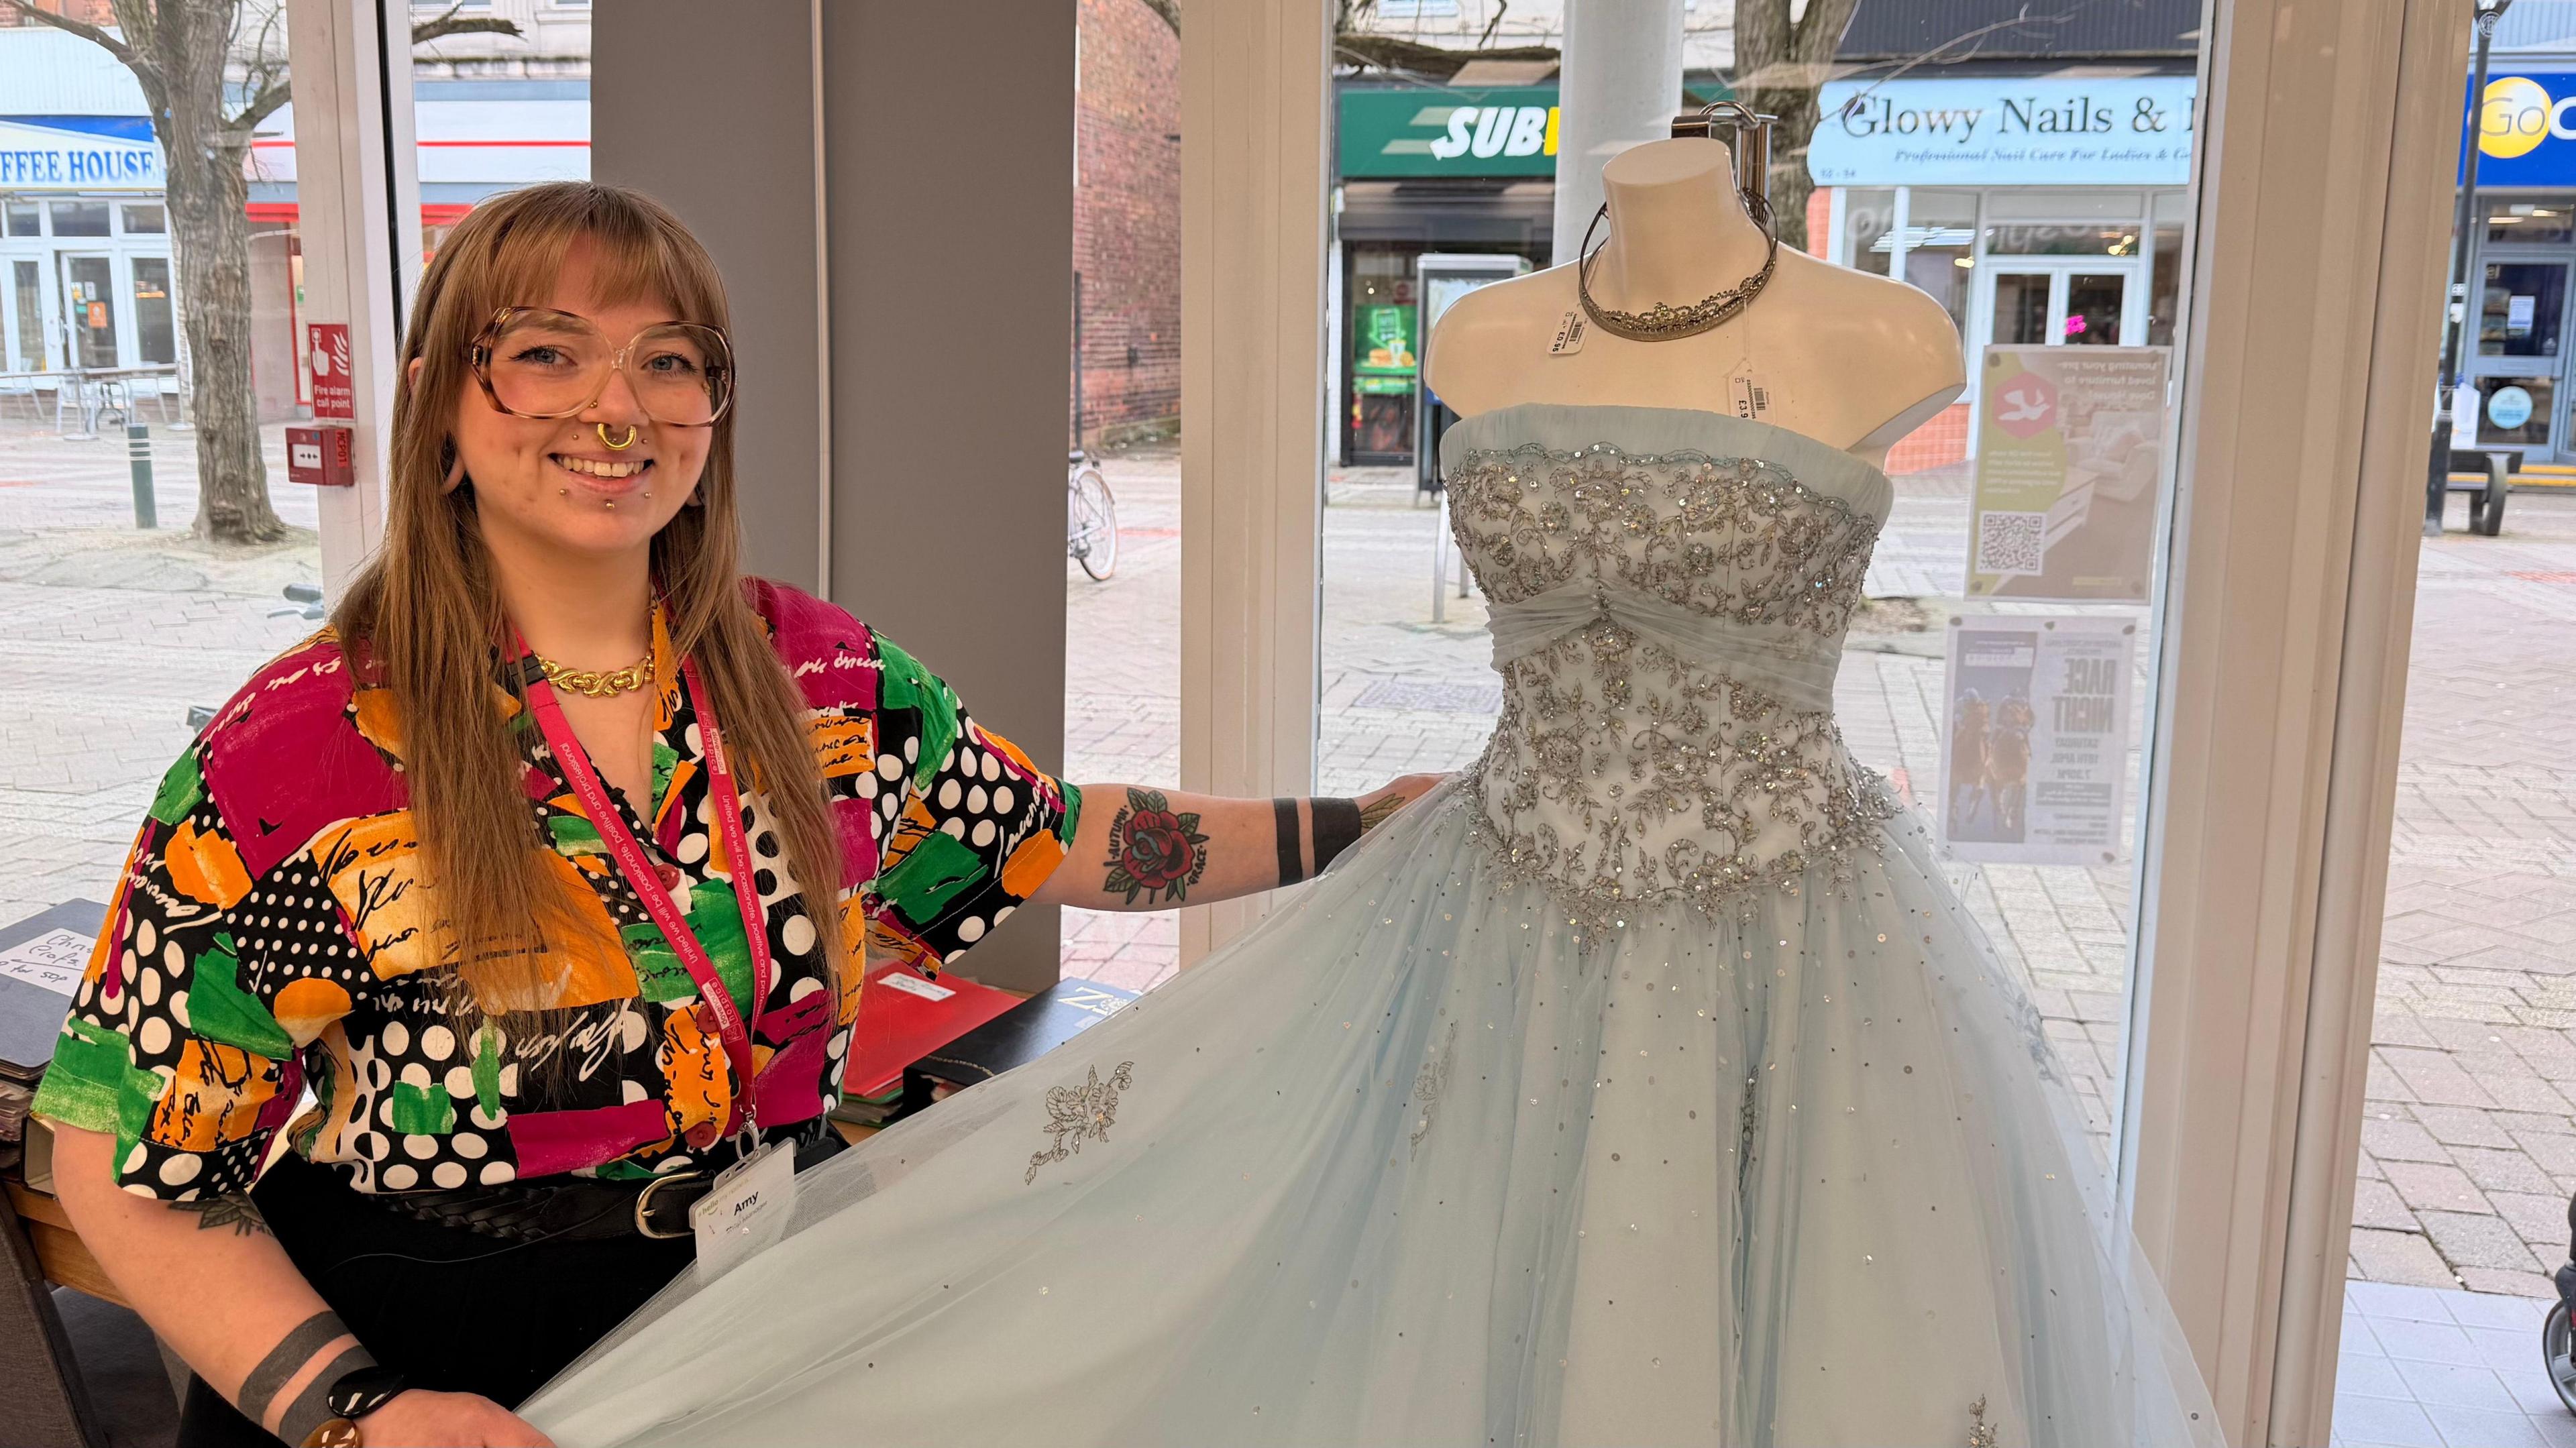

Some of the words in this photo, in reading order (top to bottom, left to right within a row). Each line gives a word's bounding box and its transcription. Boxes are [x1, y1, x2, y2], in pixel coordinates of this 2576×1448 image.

[1842, 92, 1982, 143] Glowy
[1998, 97, 2112, 134] Nails
[2133, 97, 2166, 133] &
[67, 151, 155, 181] HOUSE
[314, 384, 328, 395] Fire
[329, 386, 351, 395] alarm
[316, 398, 329, 407] call
[331, 398, 350, 409] point
[705, 730, 717, 771] hospice
[559, 742, 594, 791] professional
[585, 791, 602, 810] and
[599, 810, 623, 843] positive
[1108, 807, 1129, 856] AUTUMN
[621, 842, 654, 891] passionate,
[722, 795, 735, 822] United
[729, 824, 737, 838] we
[733, 839, 743, 852] will
[739, 871, 755, 921] passionate,
[751, 923, 763, 956] positive
[651, 891, 663, 906] be:
[659, 905, 670, 922] will
[669, 922, 680, 935] we
[676, 936, 698, 963] United
[712, 981, 735, 1021] hospice
[734, 1191, 759, 1216] Amy
